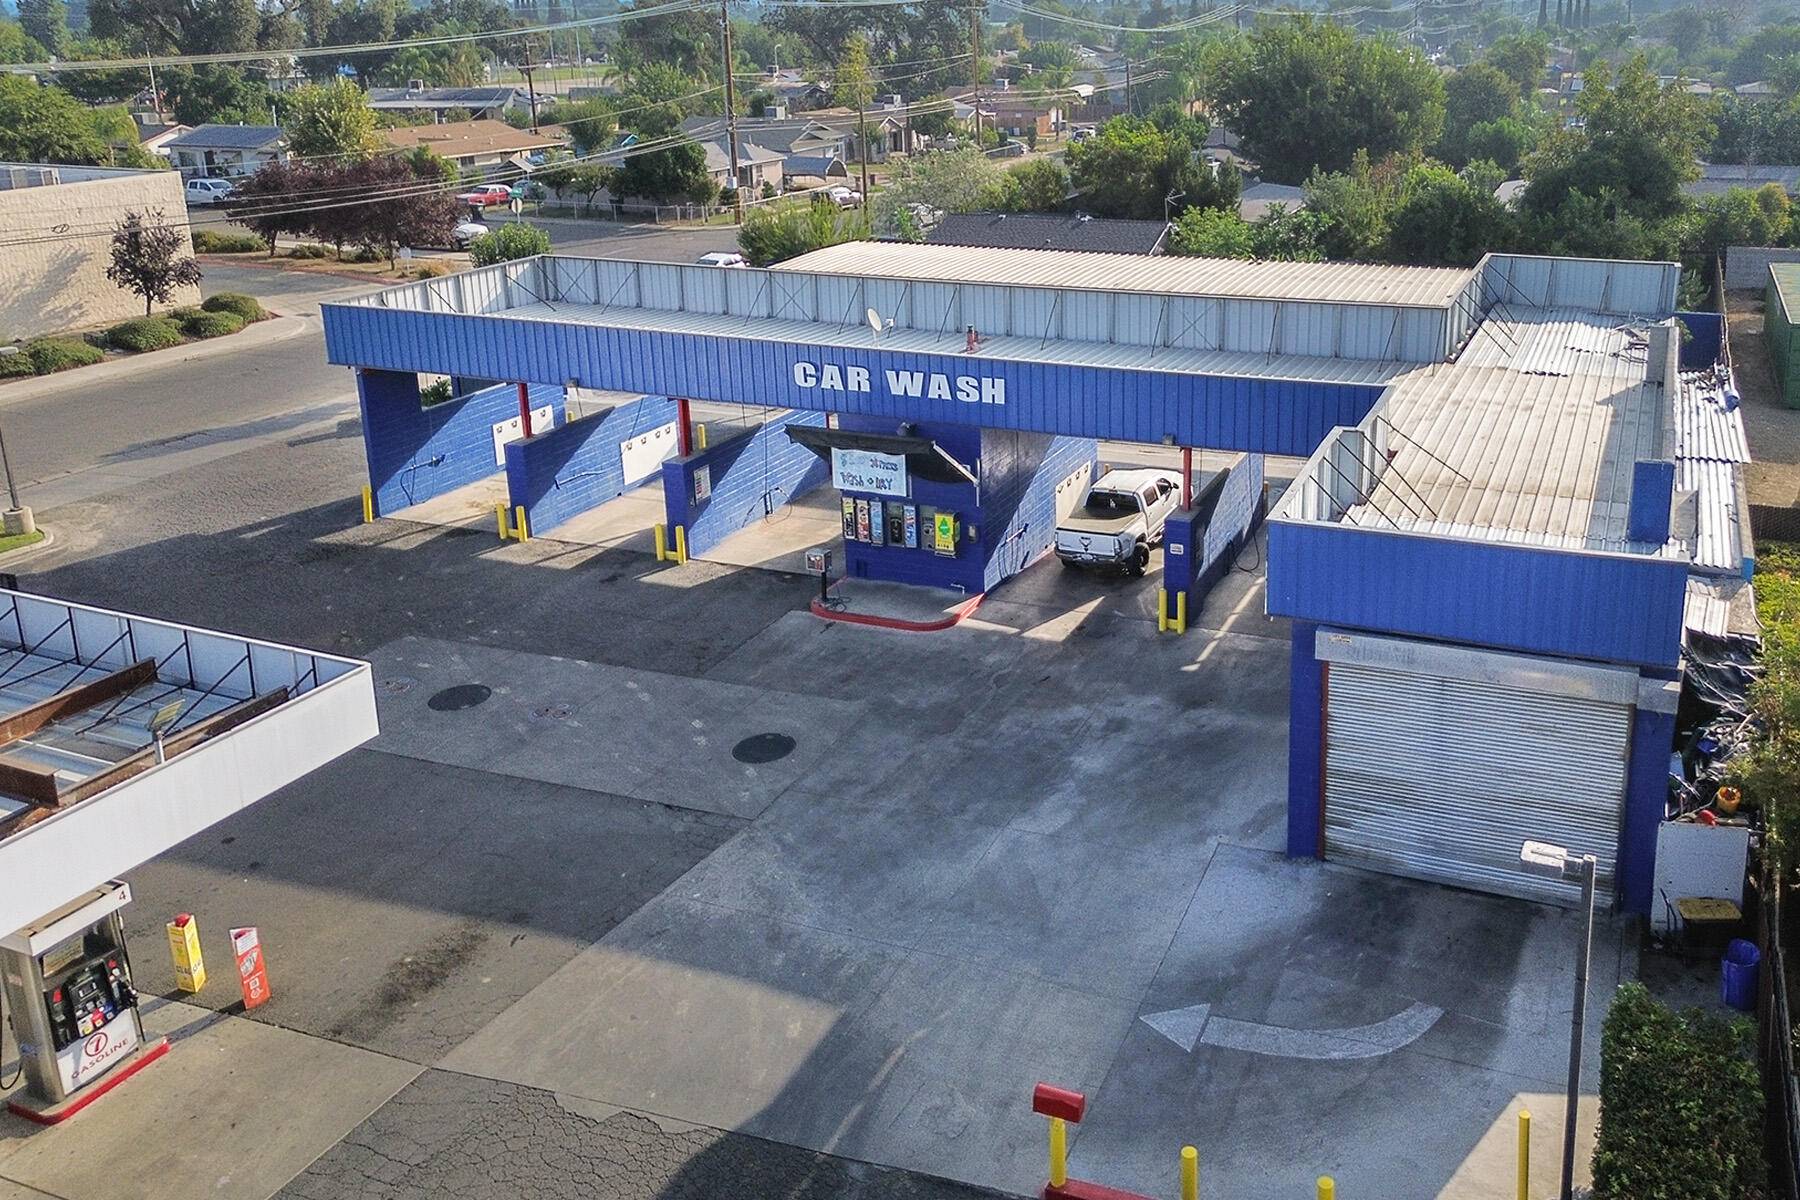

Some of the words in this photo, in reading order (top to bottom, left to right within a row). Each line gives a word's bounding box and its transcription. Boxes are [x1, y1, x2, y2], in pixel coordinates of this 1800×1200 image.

[794, 362, 871, 392] CAR
[885, 369, 1005, 405] WASH
[119, 890, 126, 900] 4
[71, 1038, 129, 1079] GASOLINE
